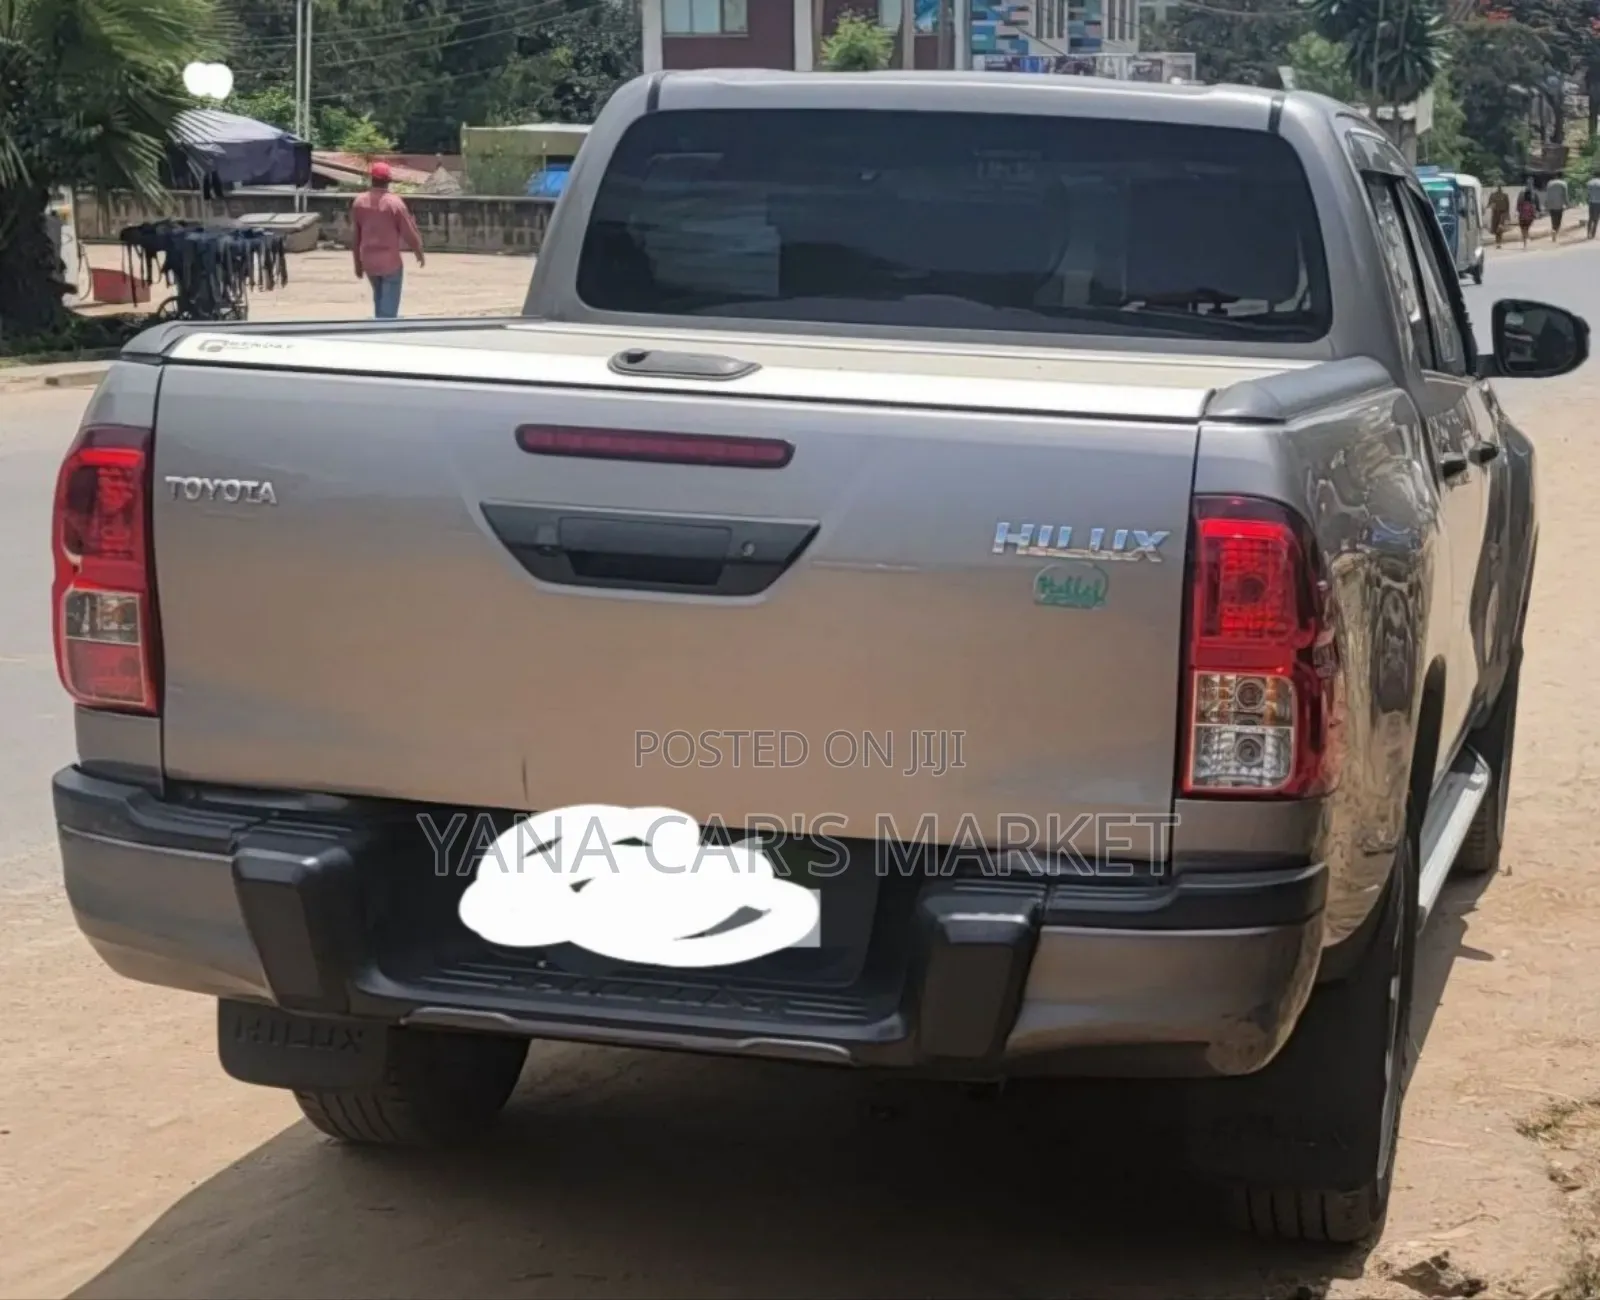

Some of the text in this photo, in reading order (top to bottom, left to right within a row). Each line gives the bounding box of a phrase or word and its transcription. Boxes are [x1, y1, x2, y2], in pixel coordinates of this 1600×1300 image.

[164, 475, 278, 505] TOYOTA
[992, 521, 1170, 562] HILUX
[236, 1015, 364, 1053] HILUX
